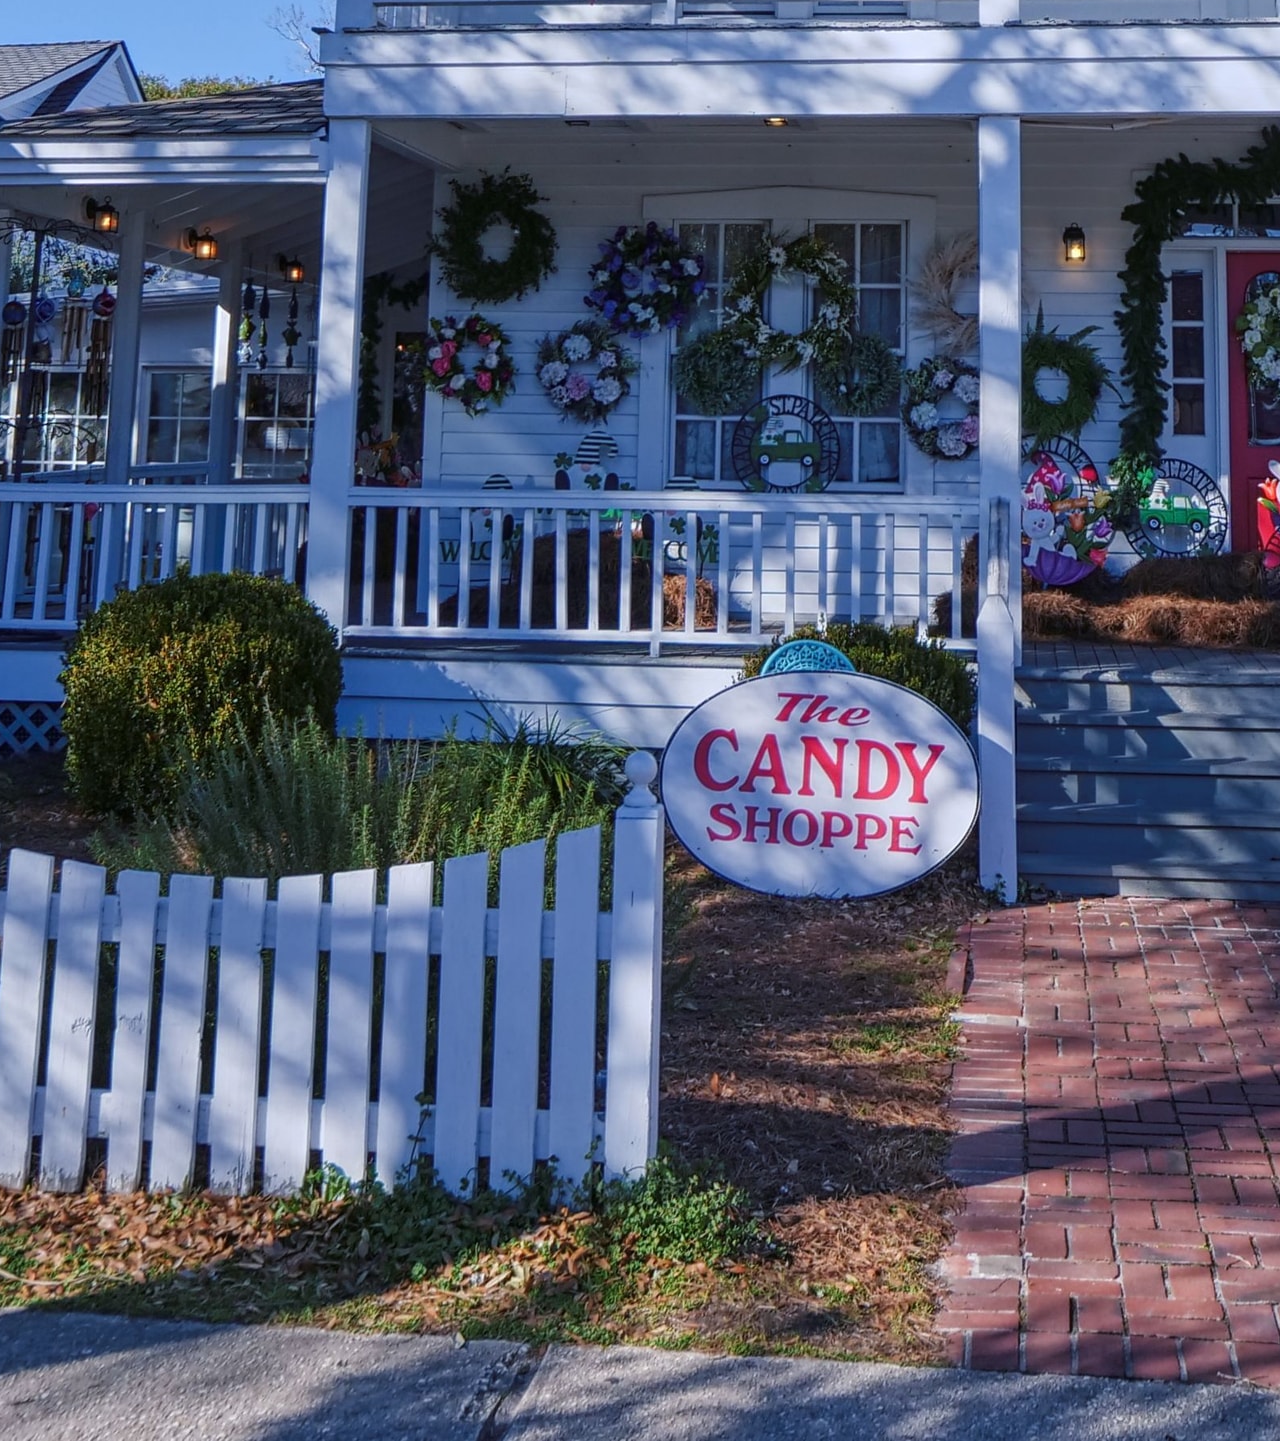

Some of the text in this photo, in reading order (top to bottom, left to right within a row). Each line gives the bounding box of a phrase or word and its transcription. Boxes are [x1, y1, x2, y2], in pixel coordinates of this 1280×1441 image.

[775, 692, 871, 727] The
[693, 728, 946, 805] CANDY
[706, 802, 923, 856] SHOPPE
